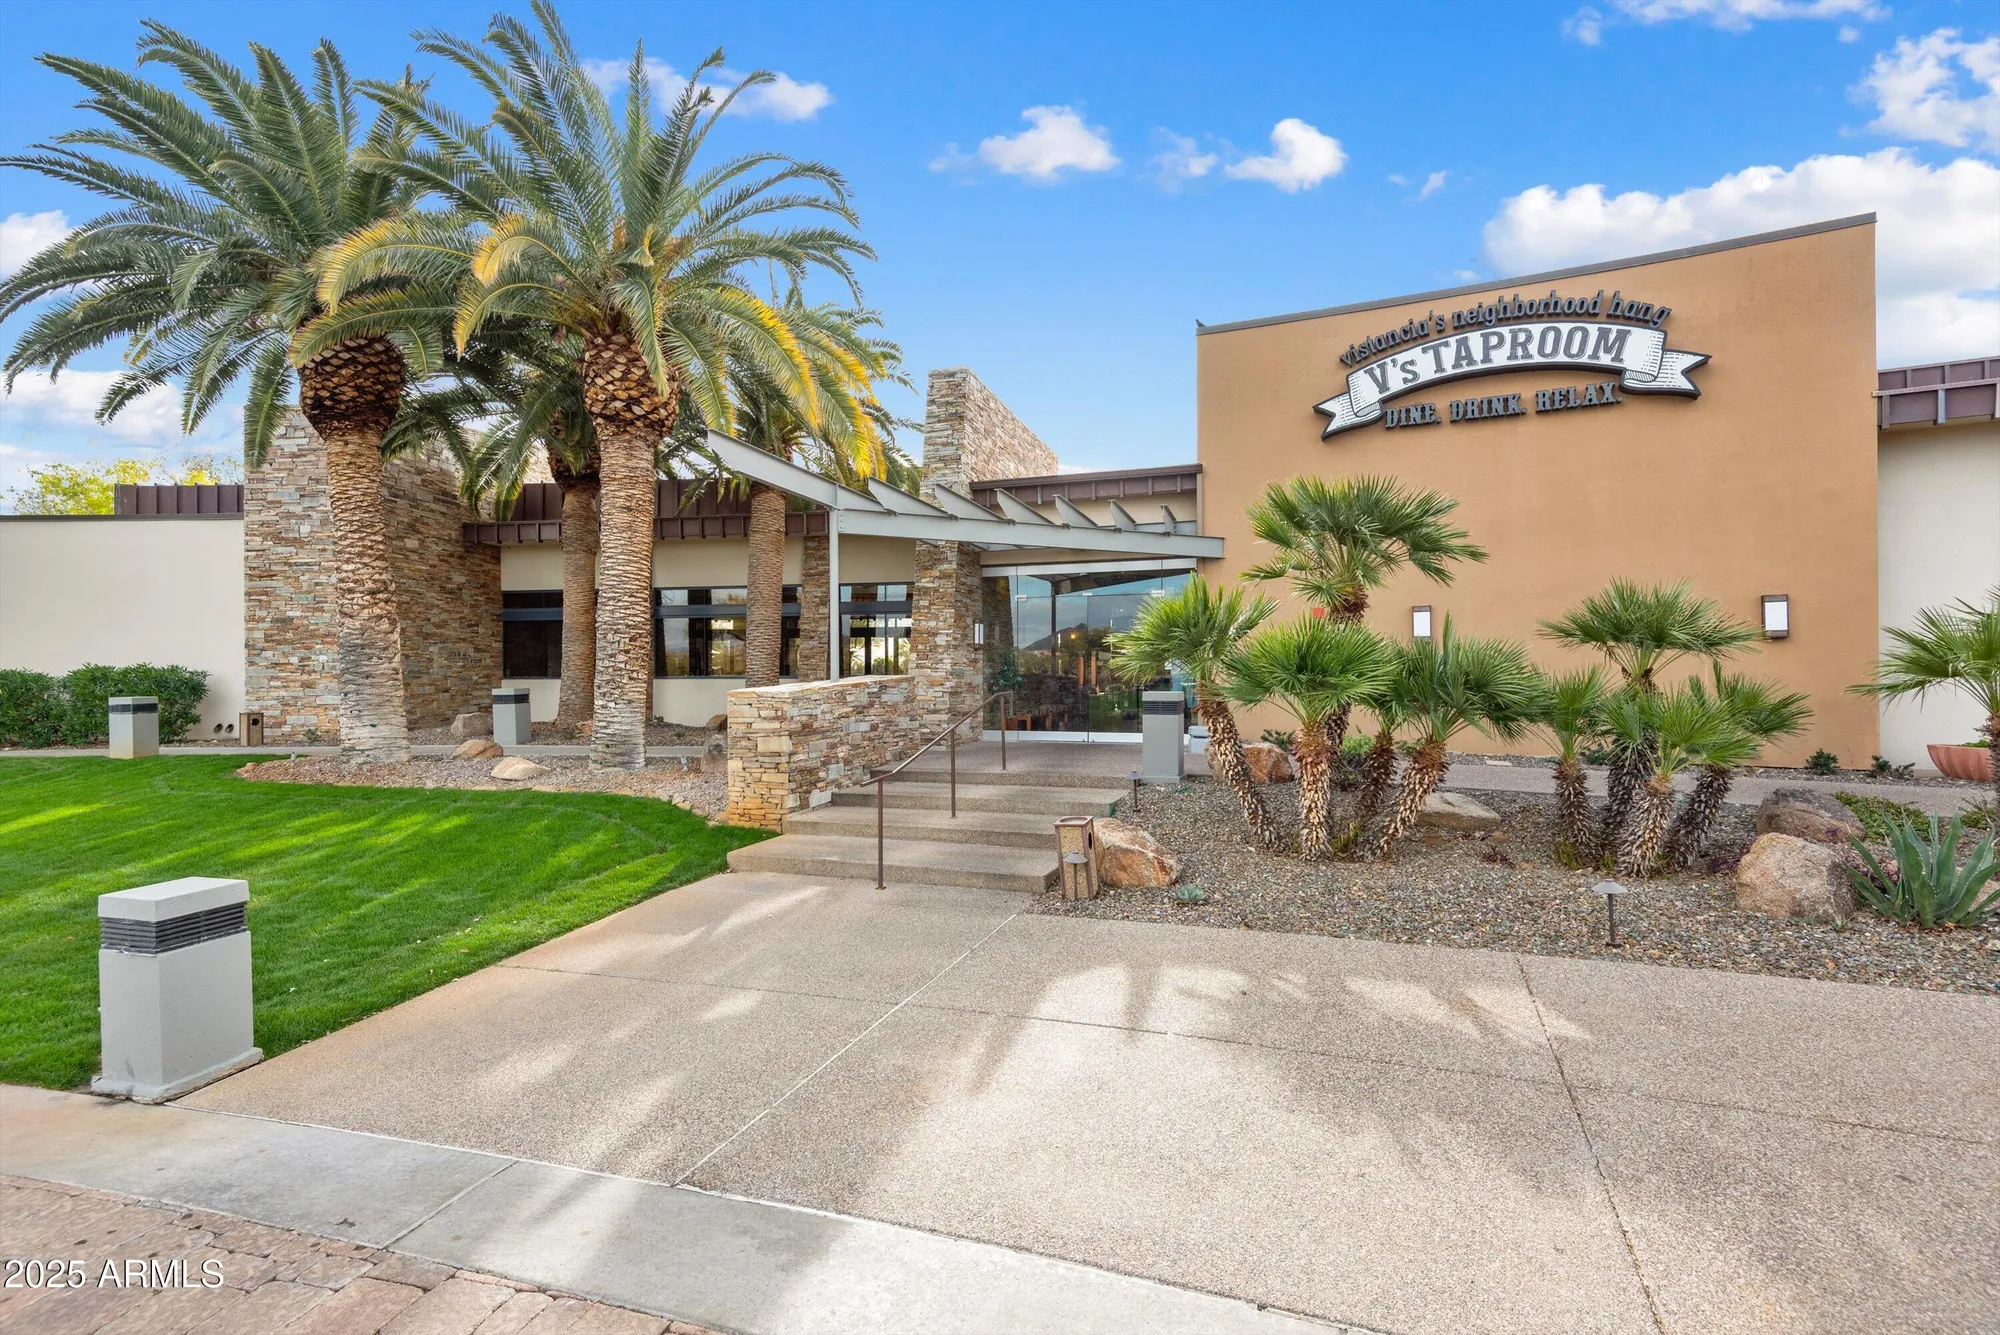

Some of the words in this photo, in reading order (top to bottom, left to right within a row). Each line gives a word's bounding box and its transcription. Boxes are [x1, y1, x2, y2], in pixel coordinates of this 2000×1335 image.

[1339, 311, 1445, 367] vistancia's
[1452, 291, 1604, 328] neighborhood
[1608, 291, 1671, 328] hang
[1364, 358, 1420, 395] V's
[1422, 325, 1632, 375] TAPROOM
[1385, 402, 1442, 429] DINE.
[1450, 393, 1528, 422] DRINK.
[1536, 382, 1624, 413] RELAX.
